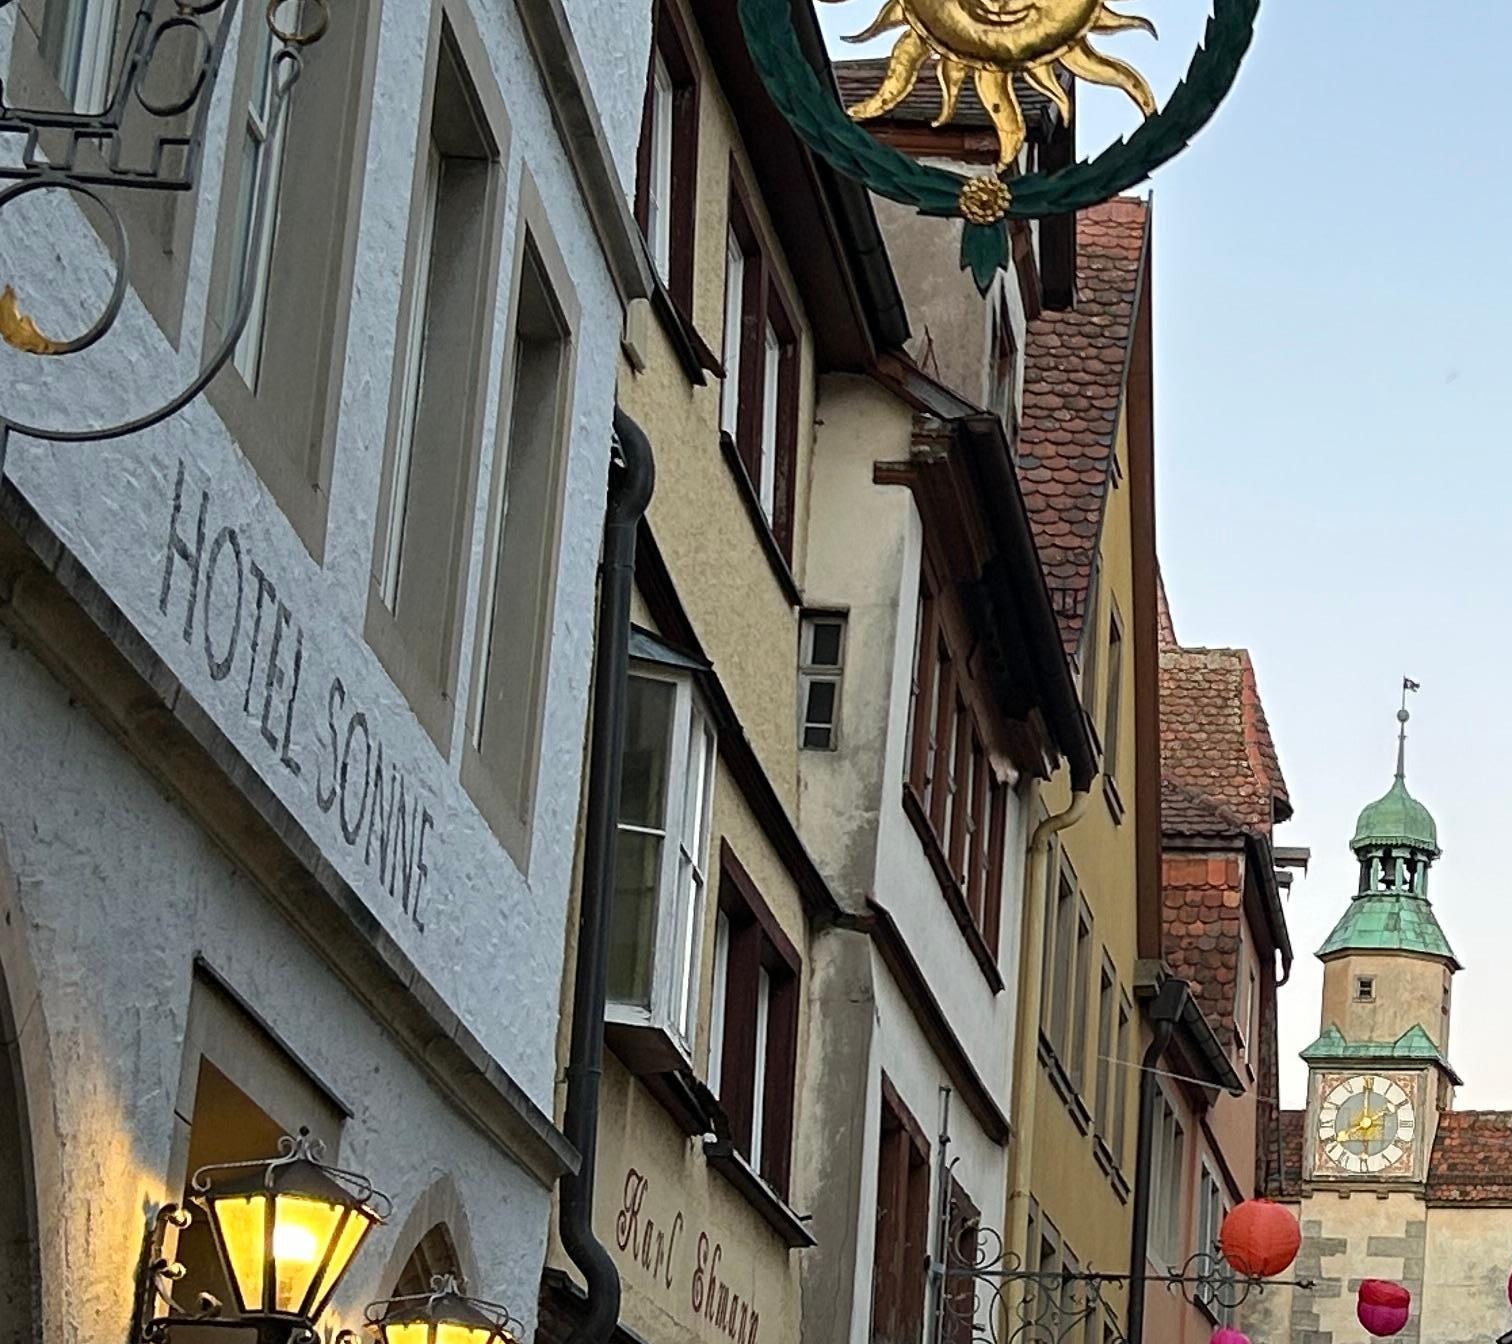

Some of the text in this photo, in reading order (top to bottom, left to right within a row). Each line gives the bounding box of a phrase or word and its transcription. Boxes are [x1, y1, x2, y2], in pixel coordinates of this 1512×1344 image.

[159, 459, 435, 935] HOTEL SONNE
[616, 1167, 684, 1291] Karl
